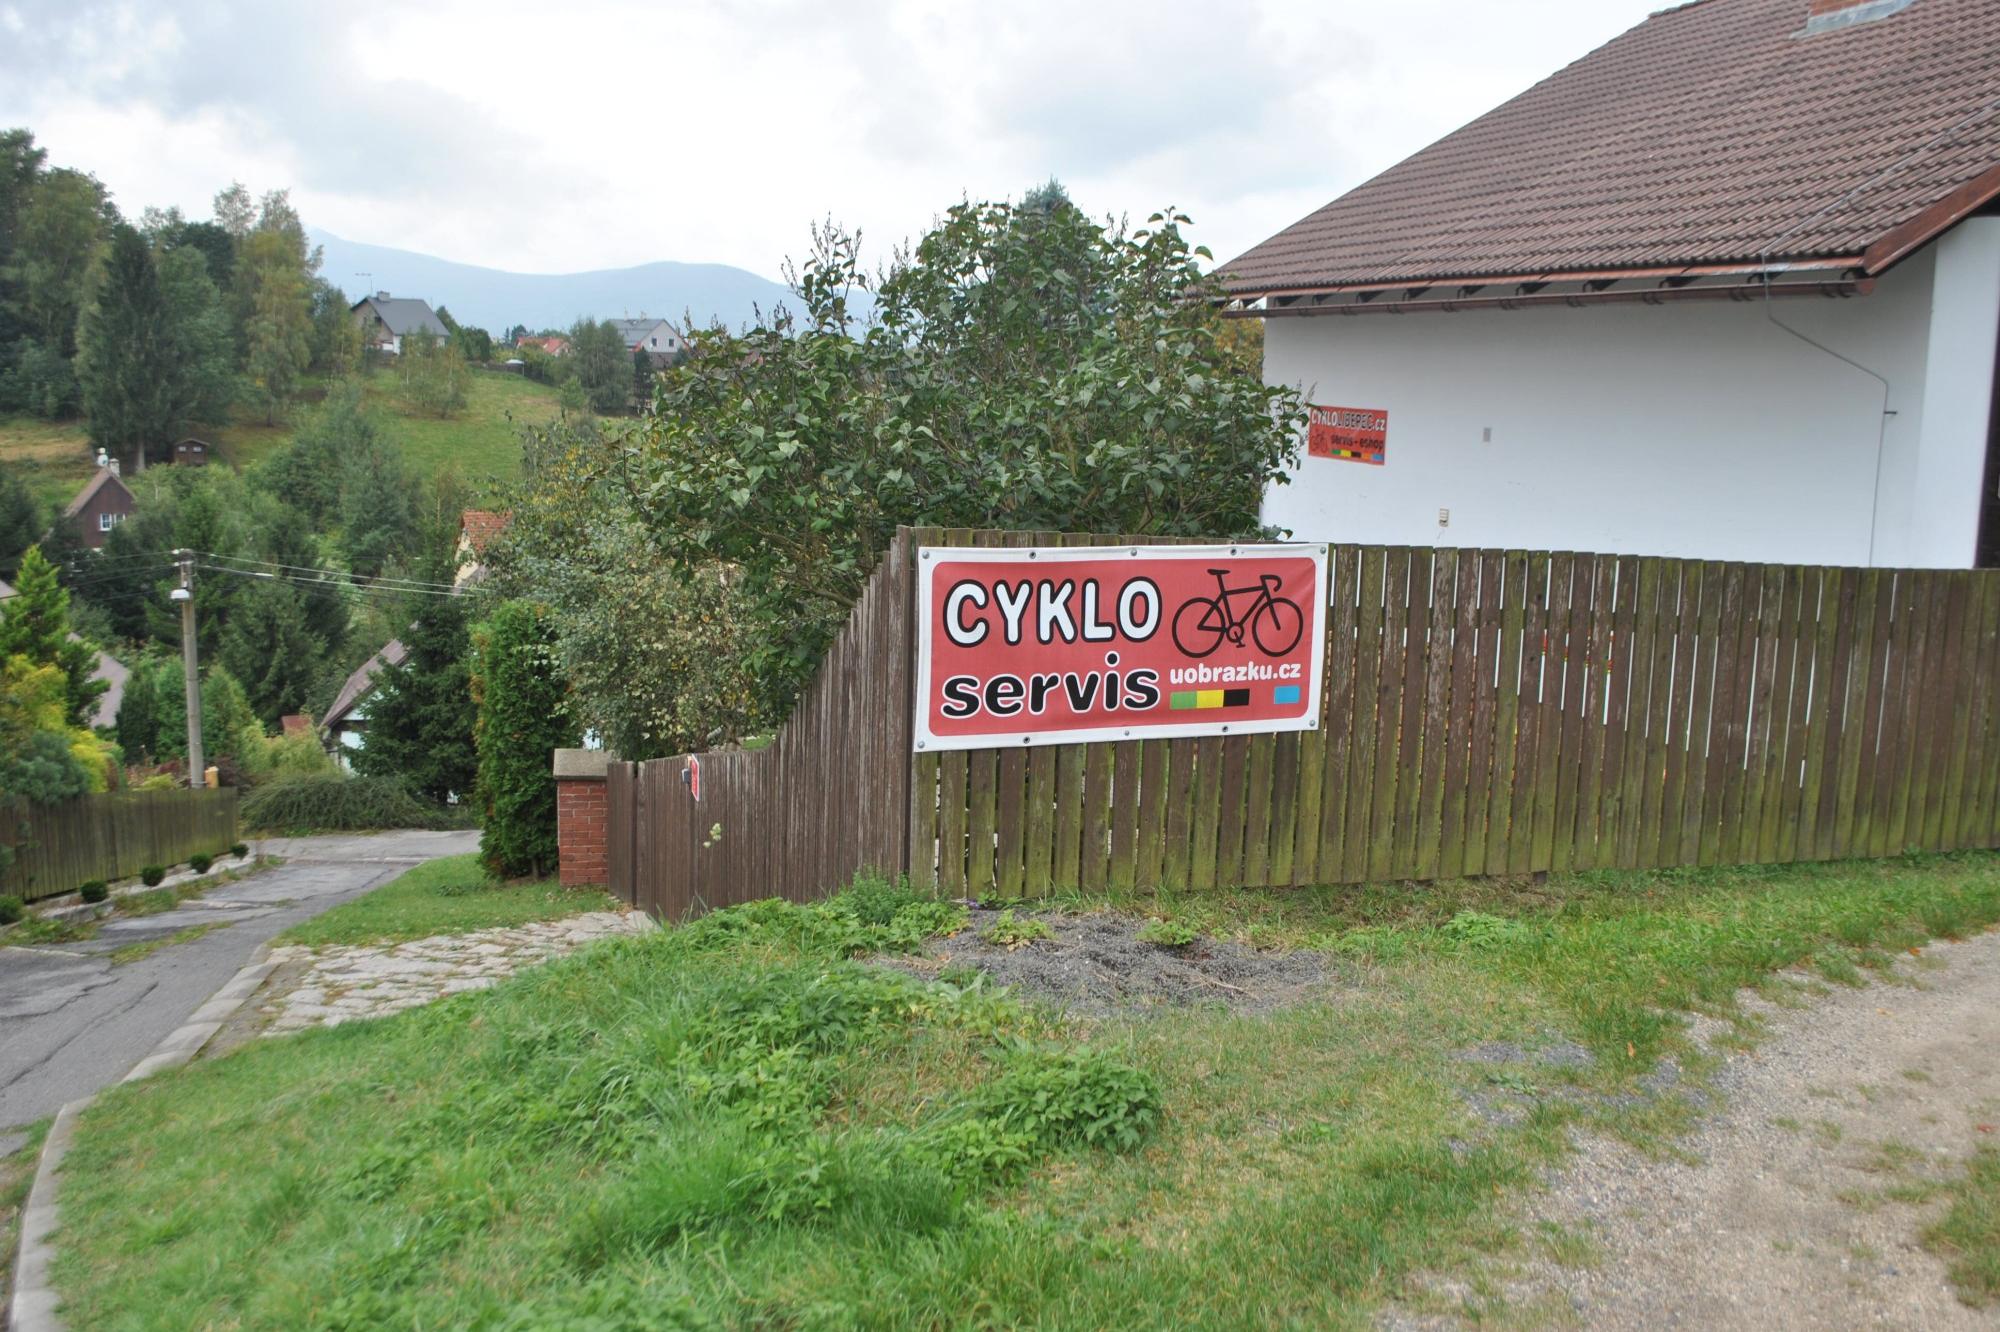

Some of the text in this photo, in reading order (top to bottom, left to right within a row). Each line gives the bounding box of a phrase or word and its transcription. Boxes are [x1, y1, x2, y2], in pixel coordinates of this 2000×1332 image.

[943, 576, 1162, 648] CYKLO
[940, 651, 1160, 718] servis
[1169, 661, 1302, 685] uobrazku.cz
